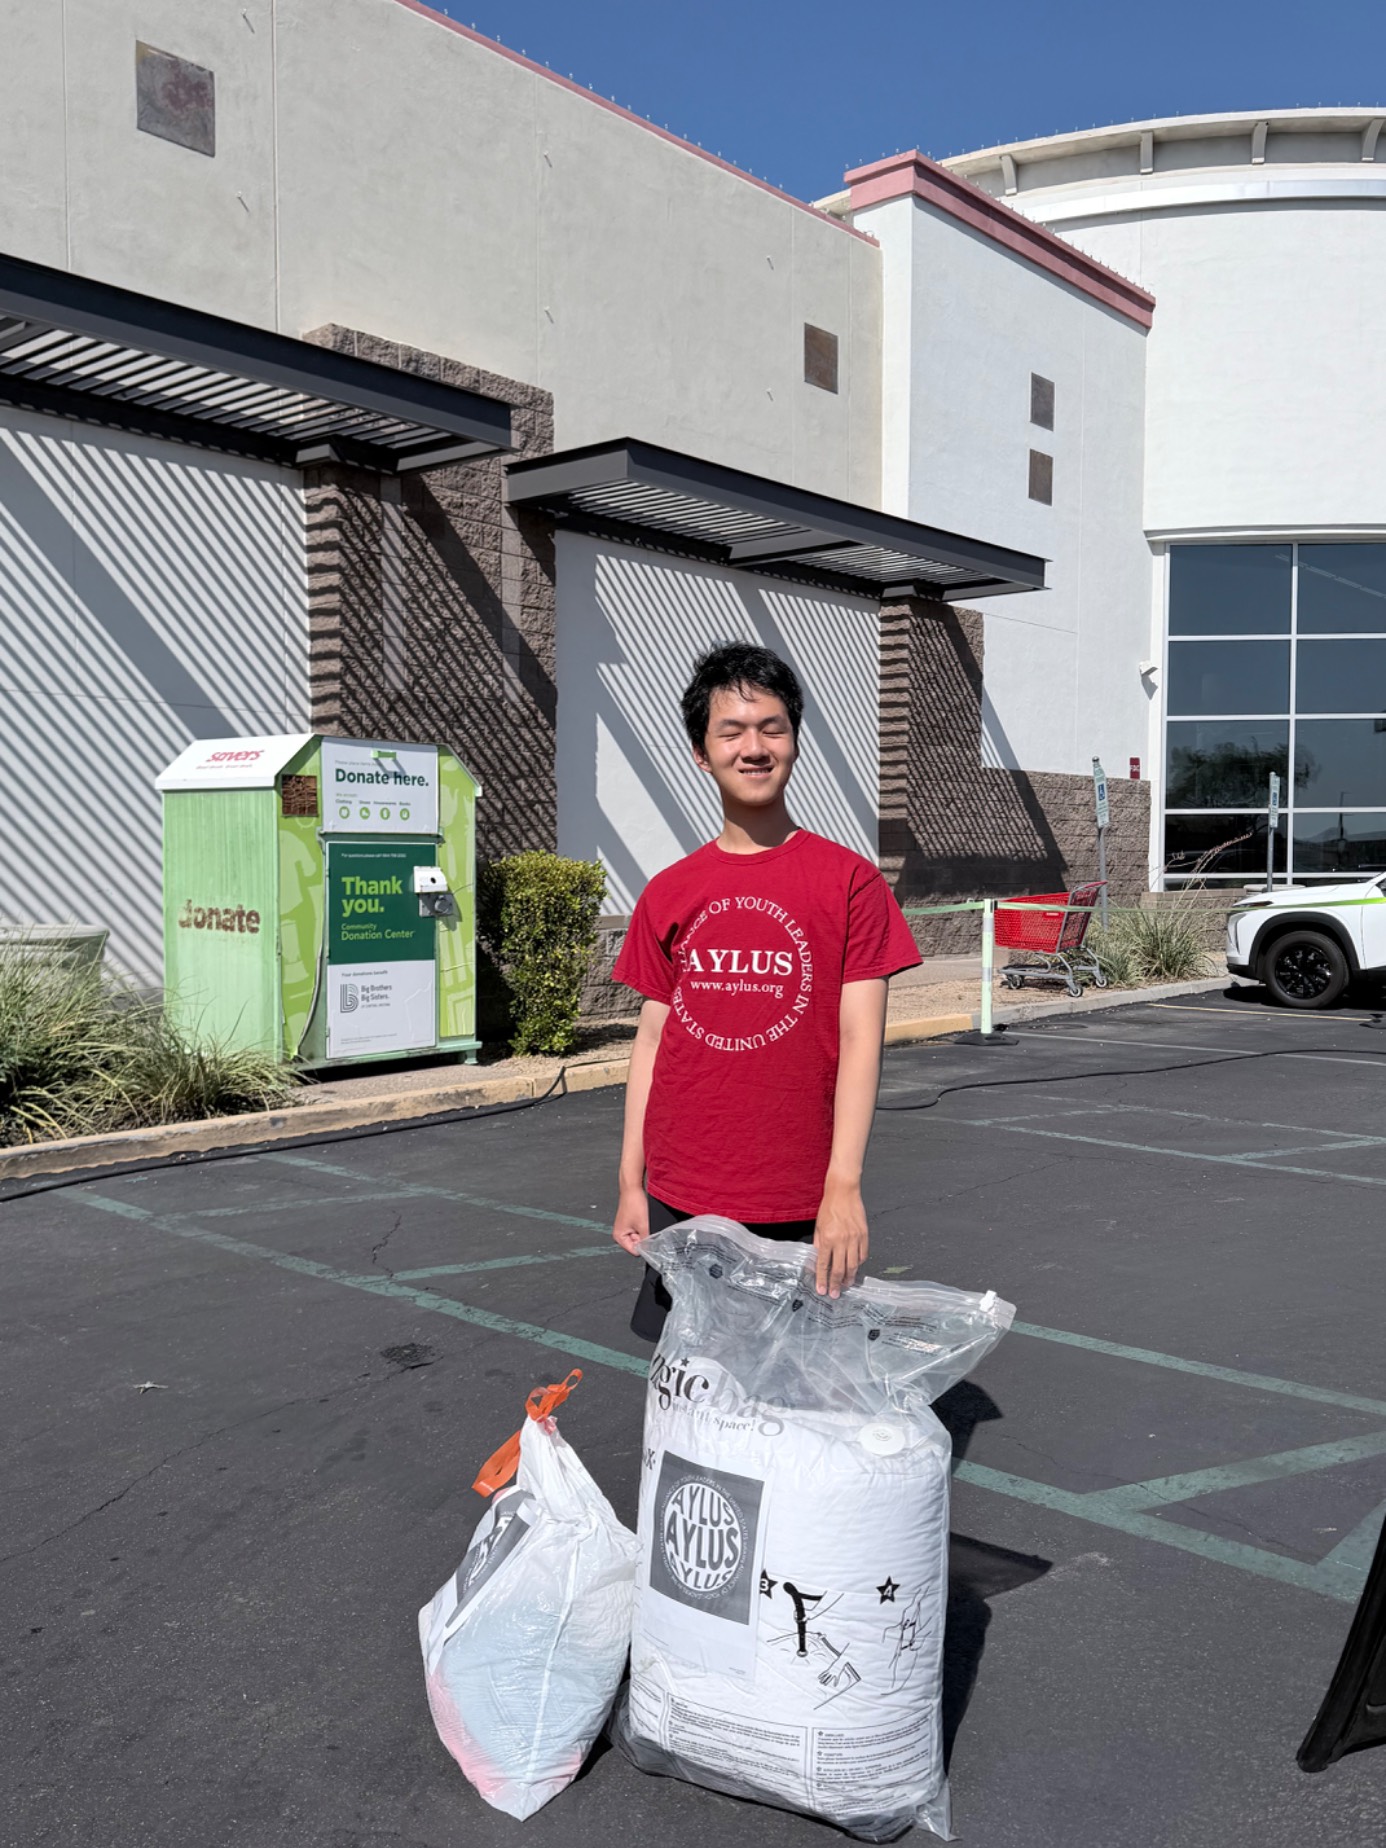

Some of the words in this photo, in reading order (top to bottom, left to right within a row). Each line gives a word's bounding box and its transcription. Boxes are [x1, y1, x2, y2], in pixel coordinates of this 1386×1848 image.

[335, 768, 389, 785] Donate
[394, 772, 429, 786] here.
[341, 876, 403, 895] Thank
[341, 898, 384, 917] you.
[709, 898, 730, 914] OF
[735, 896, 789, 923] YOUTH
[341, 923, 377, 931] Community
[341, 930, 382, 940] Donation
[384, 929, 414, 939] Center
[689, 948, 793, 976] AYLUS
[784, 919, 813, 992] LEADERS
[690, 979, 784, 999] www.aylus.org
[792, 994, 810, 1015] IN
[766, 1014, 798, 1041] THE
[705, 1033, 766, 1051] UNITED
[672, 1485, 735, 1527] AYLUS
[666, 1510, 739, 1571] AYLUS
[760, 1579, 769, 1590] 3
[884, 1586, 892, 1597] 4
